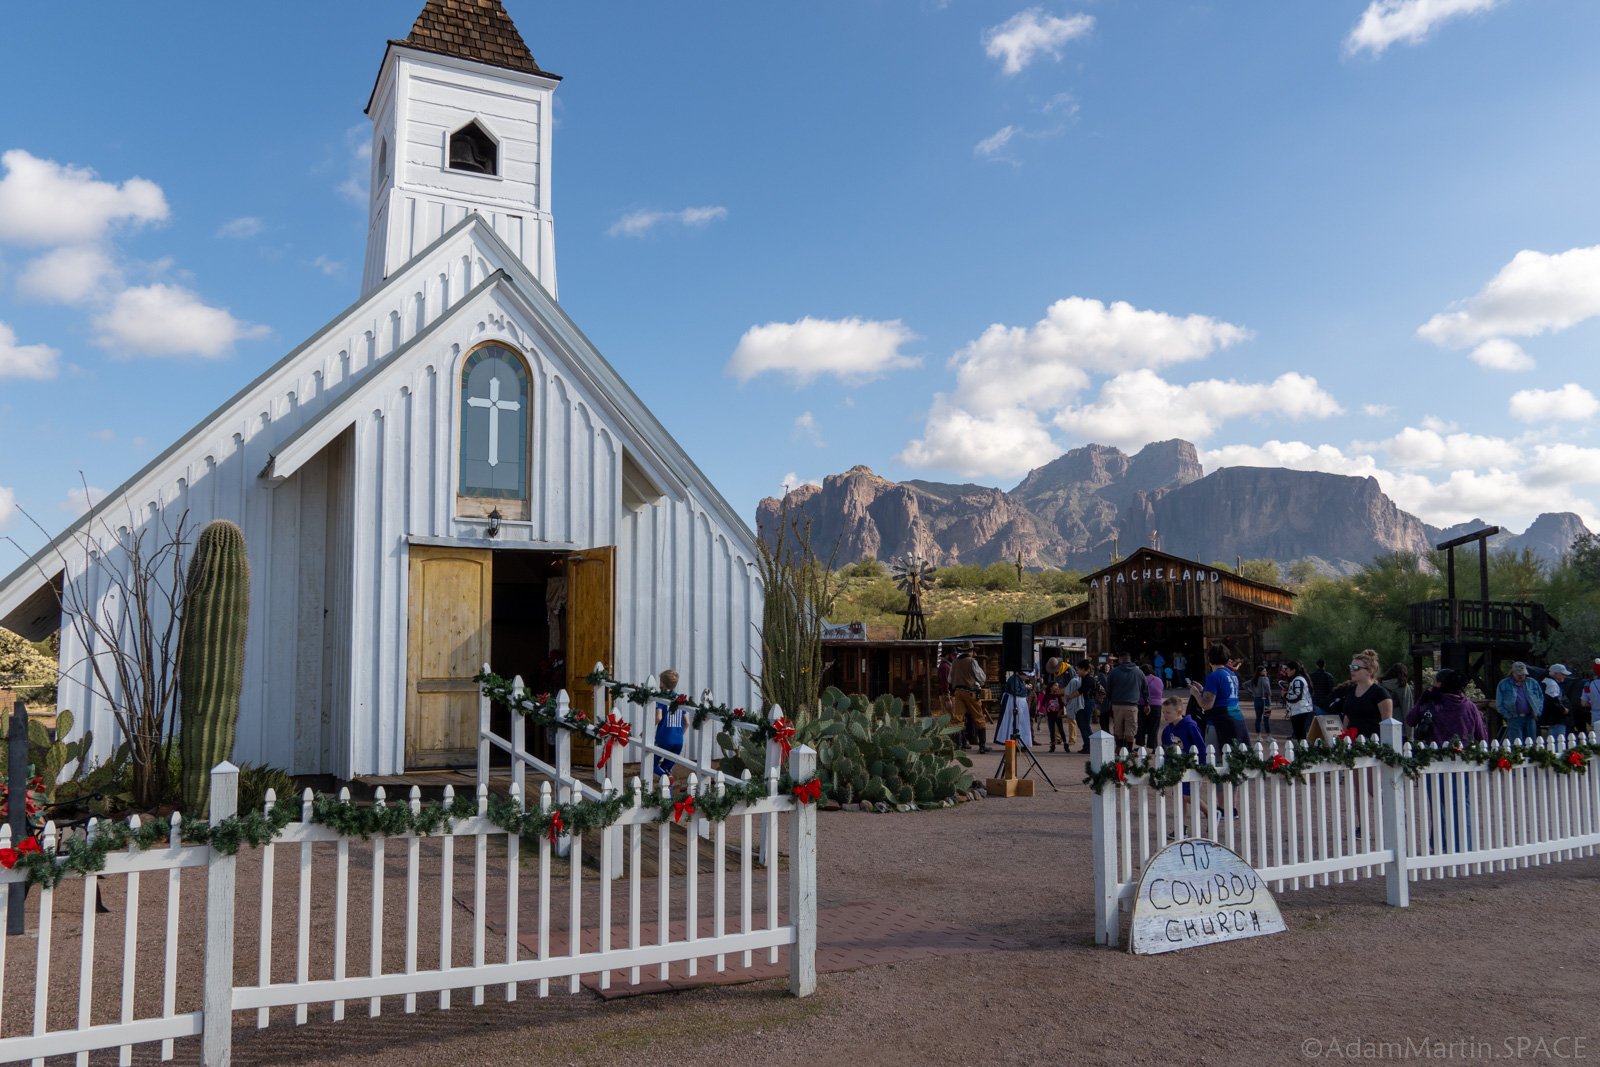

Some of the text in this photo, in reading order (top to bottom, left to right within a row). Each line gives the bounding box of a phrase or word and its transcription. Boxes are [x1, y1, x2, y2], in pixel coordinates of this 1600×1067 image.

[1090, 568, 1219, 589] APACHELAND
[1179, 841, 1212, 871] AJ
[1149, 872, 1257, 910] COWBOY
[1165, 909, 1261, 942] CHURCH
